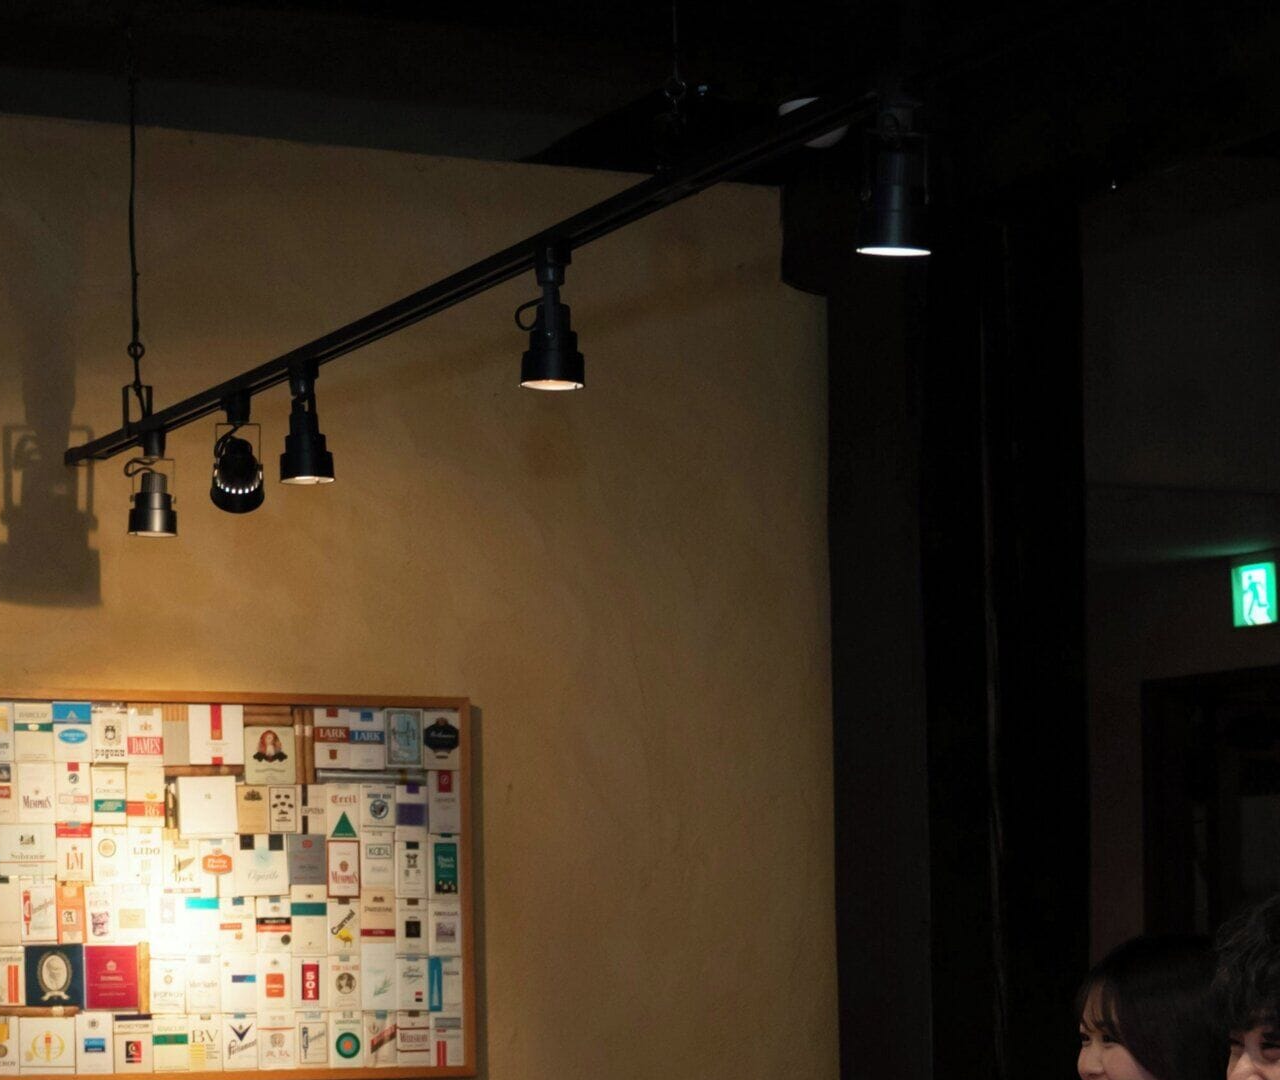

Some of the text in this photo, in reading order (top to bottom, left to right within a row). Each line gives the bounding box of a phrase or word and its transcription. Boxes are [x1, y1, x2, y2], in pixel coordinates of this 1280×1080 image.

[319, 728, 346, 738] LARK
[354, 732, 381, 741] LARK
[368, 847, 390, 856] KOOL
[331, 909, 356, 935] Camel
